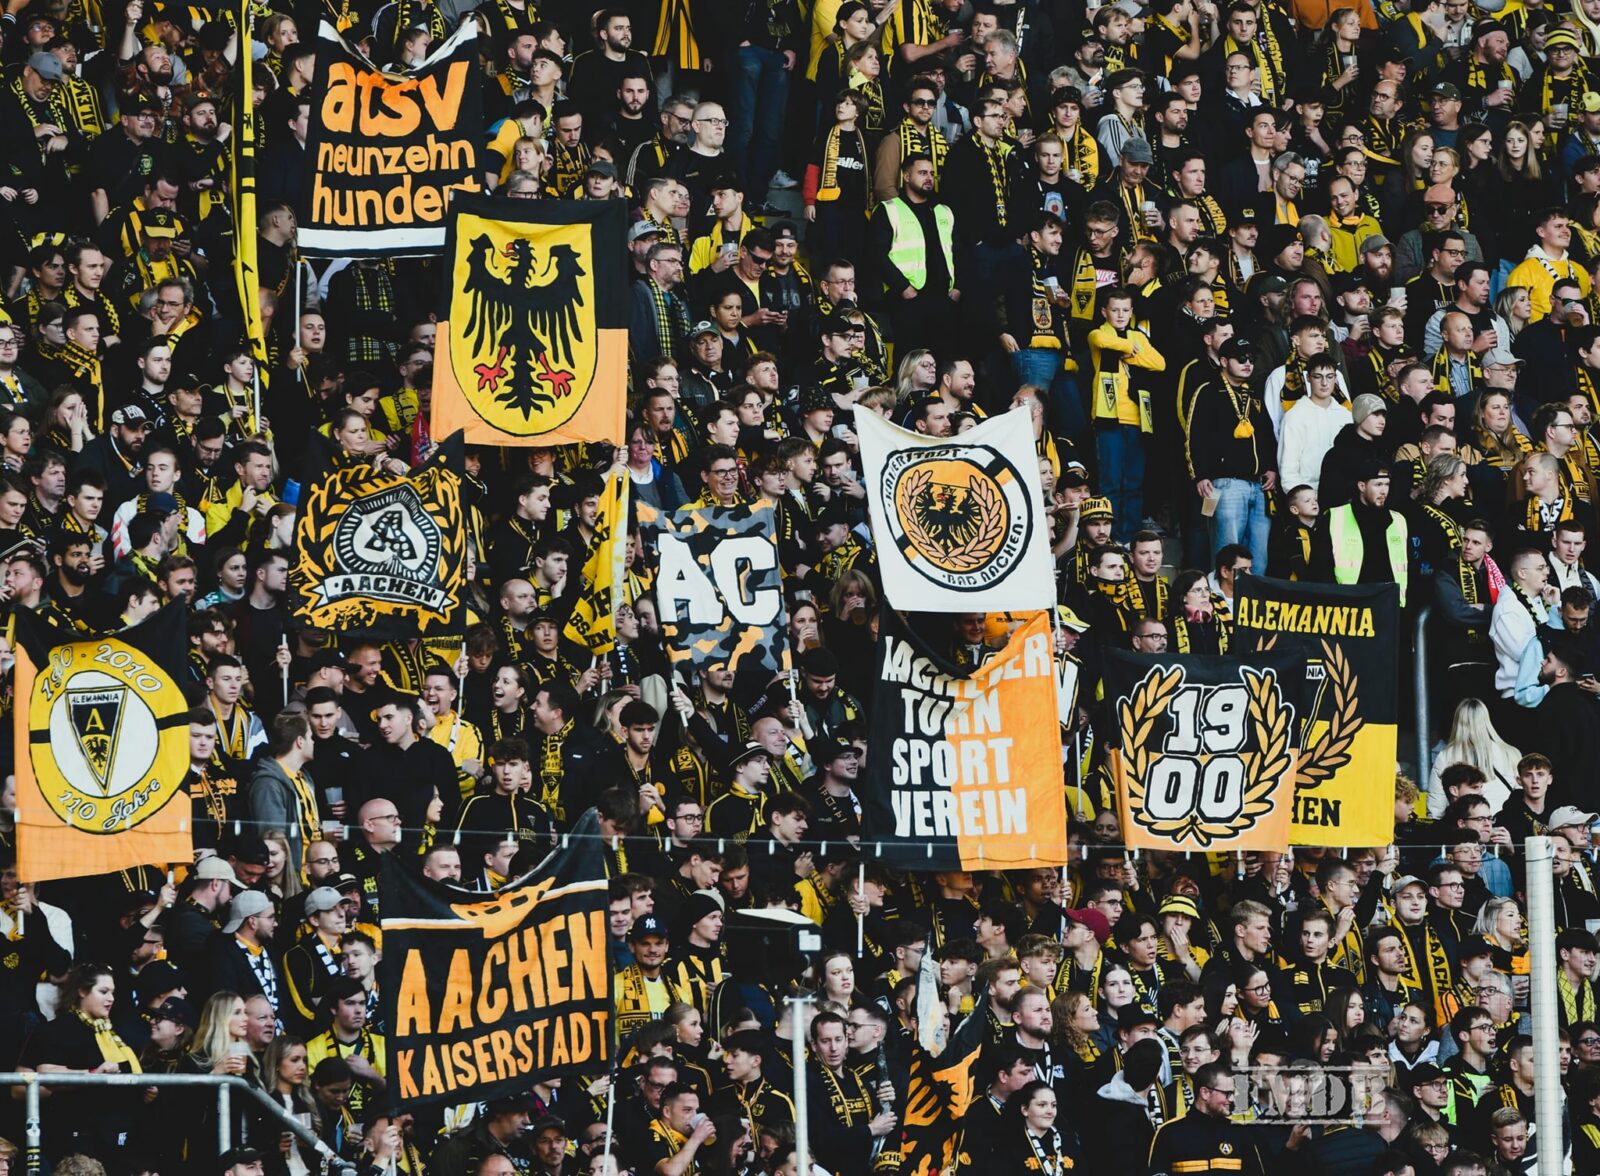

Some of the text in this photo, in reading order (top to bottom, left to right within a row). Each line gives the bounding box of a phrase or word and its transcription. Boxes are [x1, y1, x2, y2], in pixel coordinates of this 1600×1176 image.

[321, 61, 469, 137] atsv
[317, 134, 475, 176] neunzehn
[1095, 269, 1118, 282] NIKE
[341, 576, 434, 603] AACHEN
[657, 533, 781, 626] AC
[1237, 596, 1376, 638] ALEMANNIA
[94, 643, 162, 693] 2010
[71, 692, 120, 704] ALEMANNIA
[85, 708, 105, 732] A
[1163, 684, 1251, 755] 19
[892, 737, 1013, 787] SPORT
[57, 778, 161, 832] 110 Jahre
[891, 787, 1028, 837] VEREIN
[1144, 754, 1245, 824] 00
[396, 910, 608, 1037] AACHEN
[397, 1011, 609, 1099] KAISERSTADT
